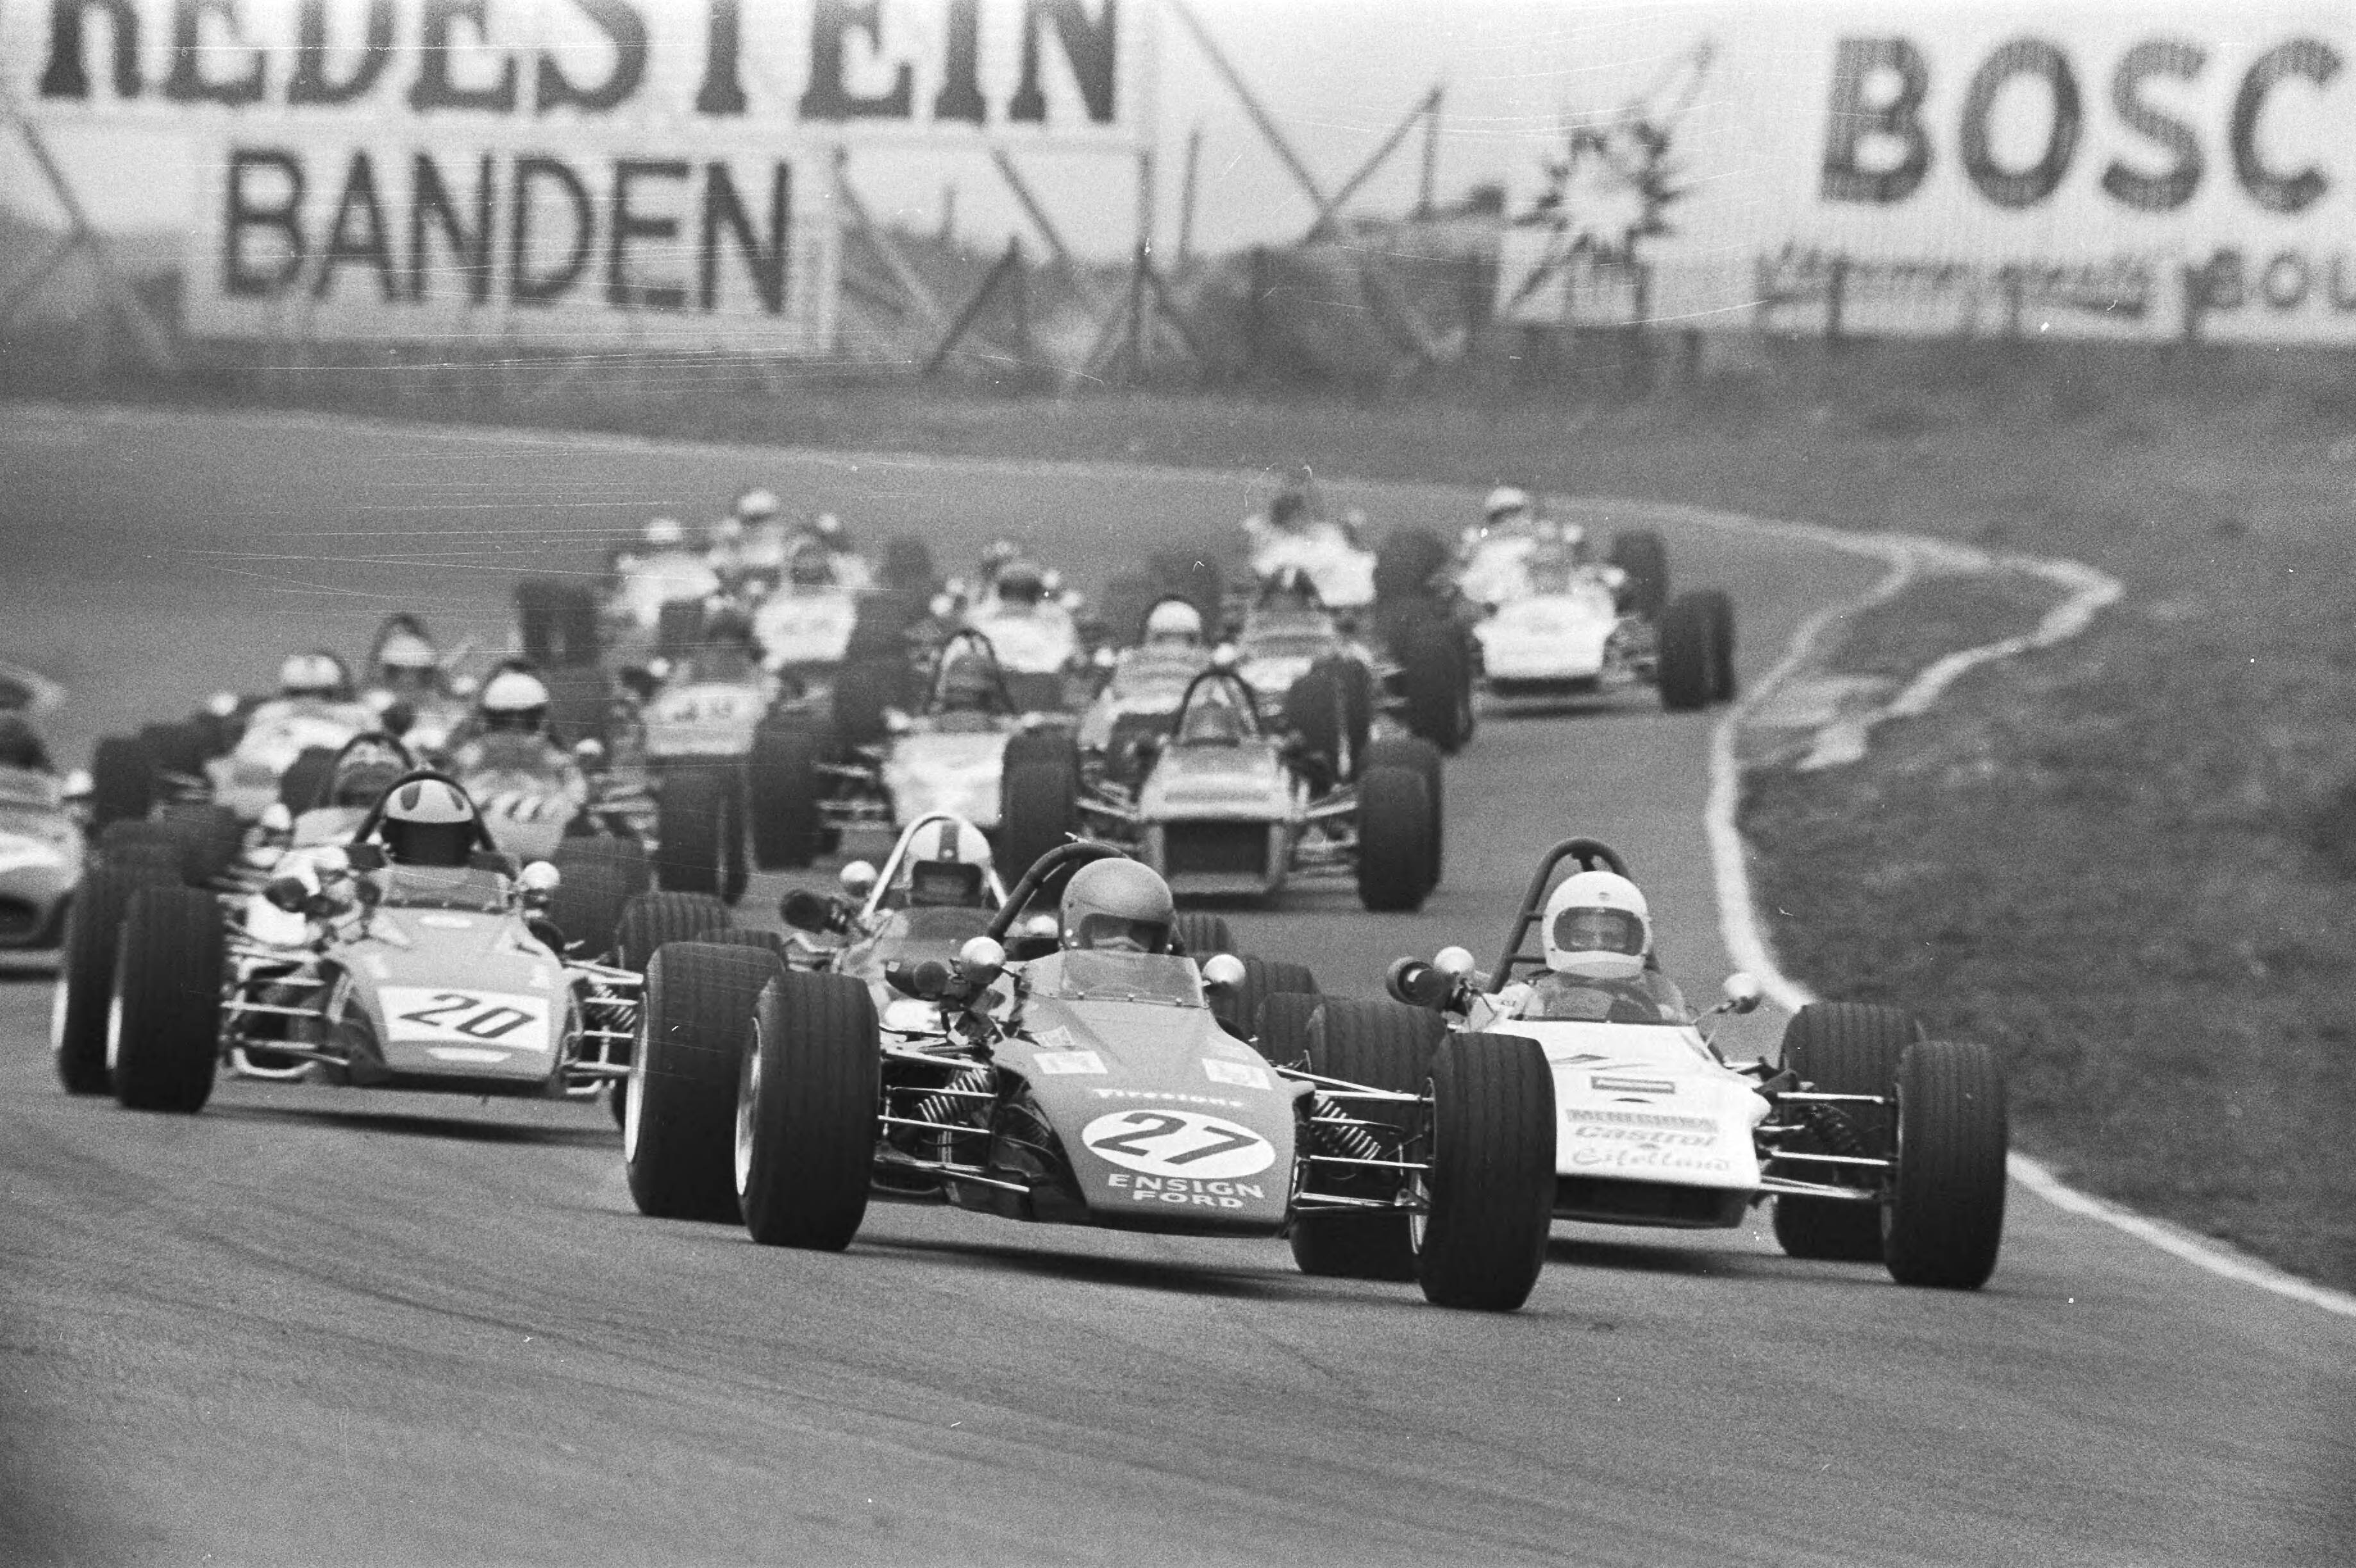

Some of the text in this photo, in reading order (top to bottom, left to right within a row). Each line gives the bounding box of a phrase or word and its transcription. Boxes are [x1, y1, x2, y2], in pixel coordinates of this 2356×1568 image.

[1819, 35, 2343, 213] BOSC
[221, 147, 790, 316] BANDEN
[399, 993, 538, 1039] 20
[1090, 1112, 1260, 1165] 27
[1107, 1173, 1265, 1199] ENSIGN
[1132, 1190, 1244, 1208] FORD
